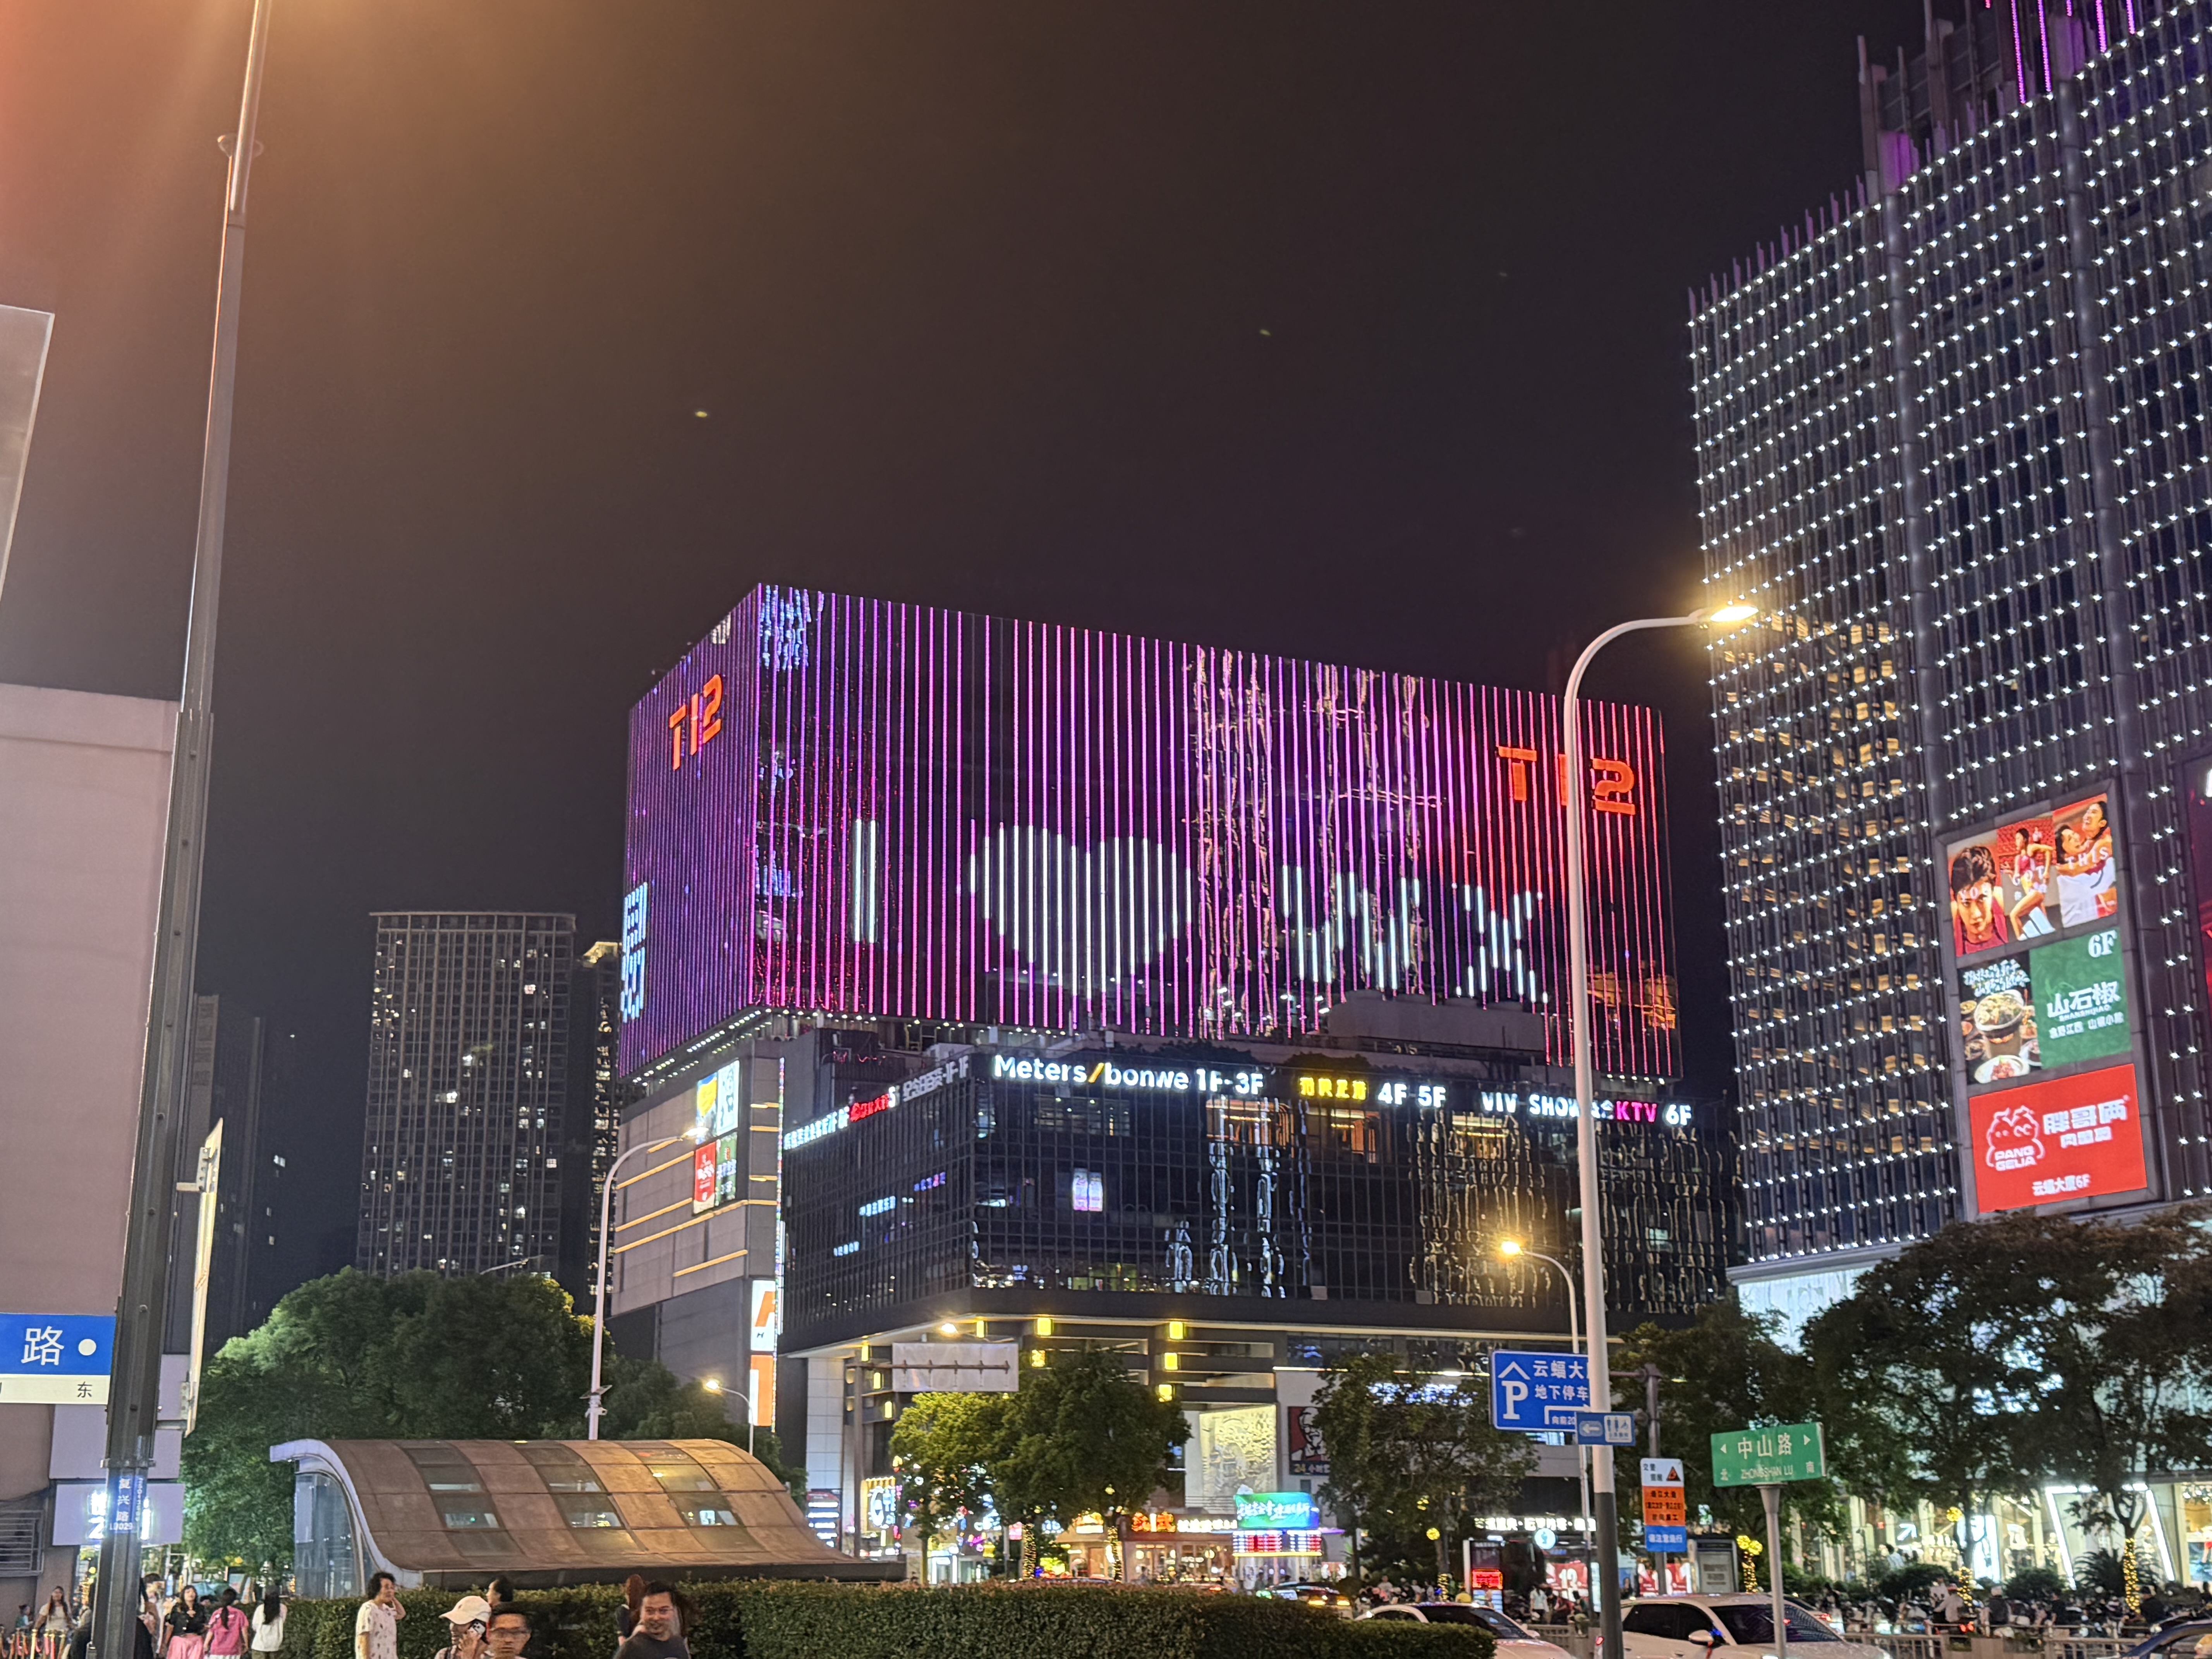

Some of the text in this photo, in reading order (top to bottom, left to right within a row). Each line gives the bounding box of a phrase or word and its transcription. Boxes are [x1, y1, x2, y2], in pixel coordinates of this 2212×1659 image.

[669, 674, 723, 771] T12
[2064, 847, 2109, 870] THIS
[2088, 930, 2117, 958] 6F
[2046, 981, 2121, 1018] 山石椒
[994, 1054, 1189, 1089] Meters/bonwe
[1196, 1068, 1264, 1095] 1F-3F
[1480, 1092, 1518, 1113] VIV
[1615, 1101, 1658, 1122] KTV
[1665, 1104, 1692, 1126] 6F
[1994, 1145, 2033, 1161] PANG
[21, 1326, 64, 1366] 路
[1532, 1360, 1590, 1379] 云蝠大
[77, 1381, 93, 1398] 东
[1501, 1380, 1529, 1420] P
[1534, 1384, 1589, 1401] 地下停车
[1738, 1432, 1792, 1460] 中山路
[1784, 1464, 1793, 1475] LU
